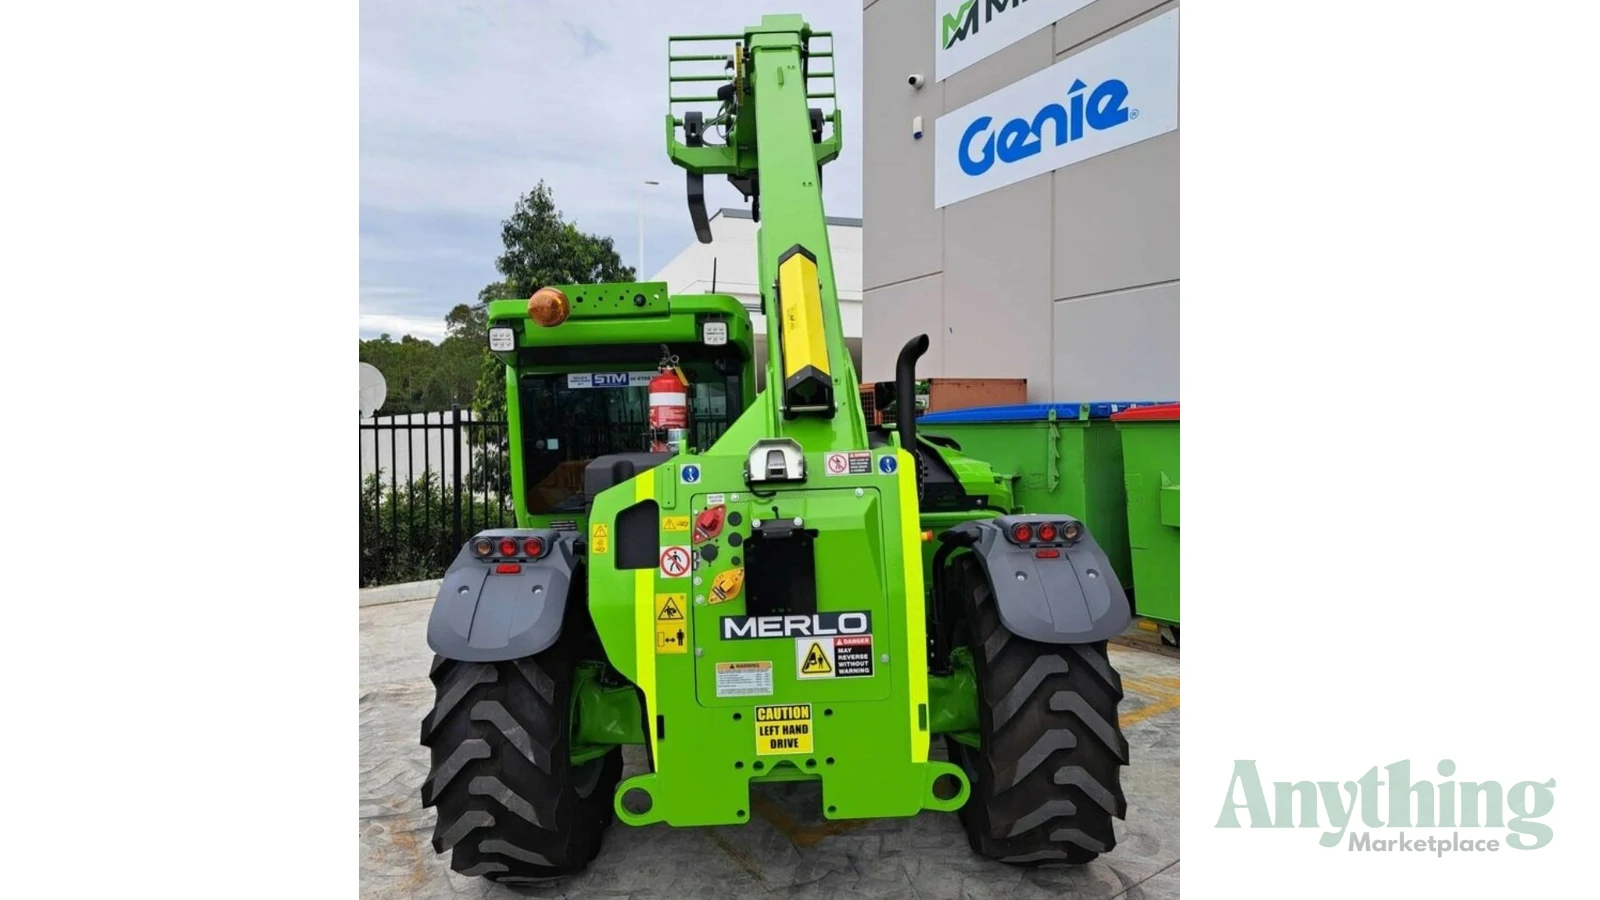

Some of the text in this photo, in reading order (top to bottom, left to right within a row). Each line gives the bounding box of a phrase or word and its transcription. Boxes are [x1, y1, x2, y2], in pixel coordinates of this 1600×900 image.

[958, 78, 1129, 177] Genie
[594, 373, 627, 384] STM
[724, 612, 868, 639] MERLO
[757, 706, 809, 721] CAUTION
[759, 724, 808, 736] LEFT HAND
[770, 738, 799, 749] DRIVE
